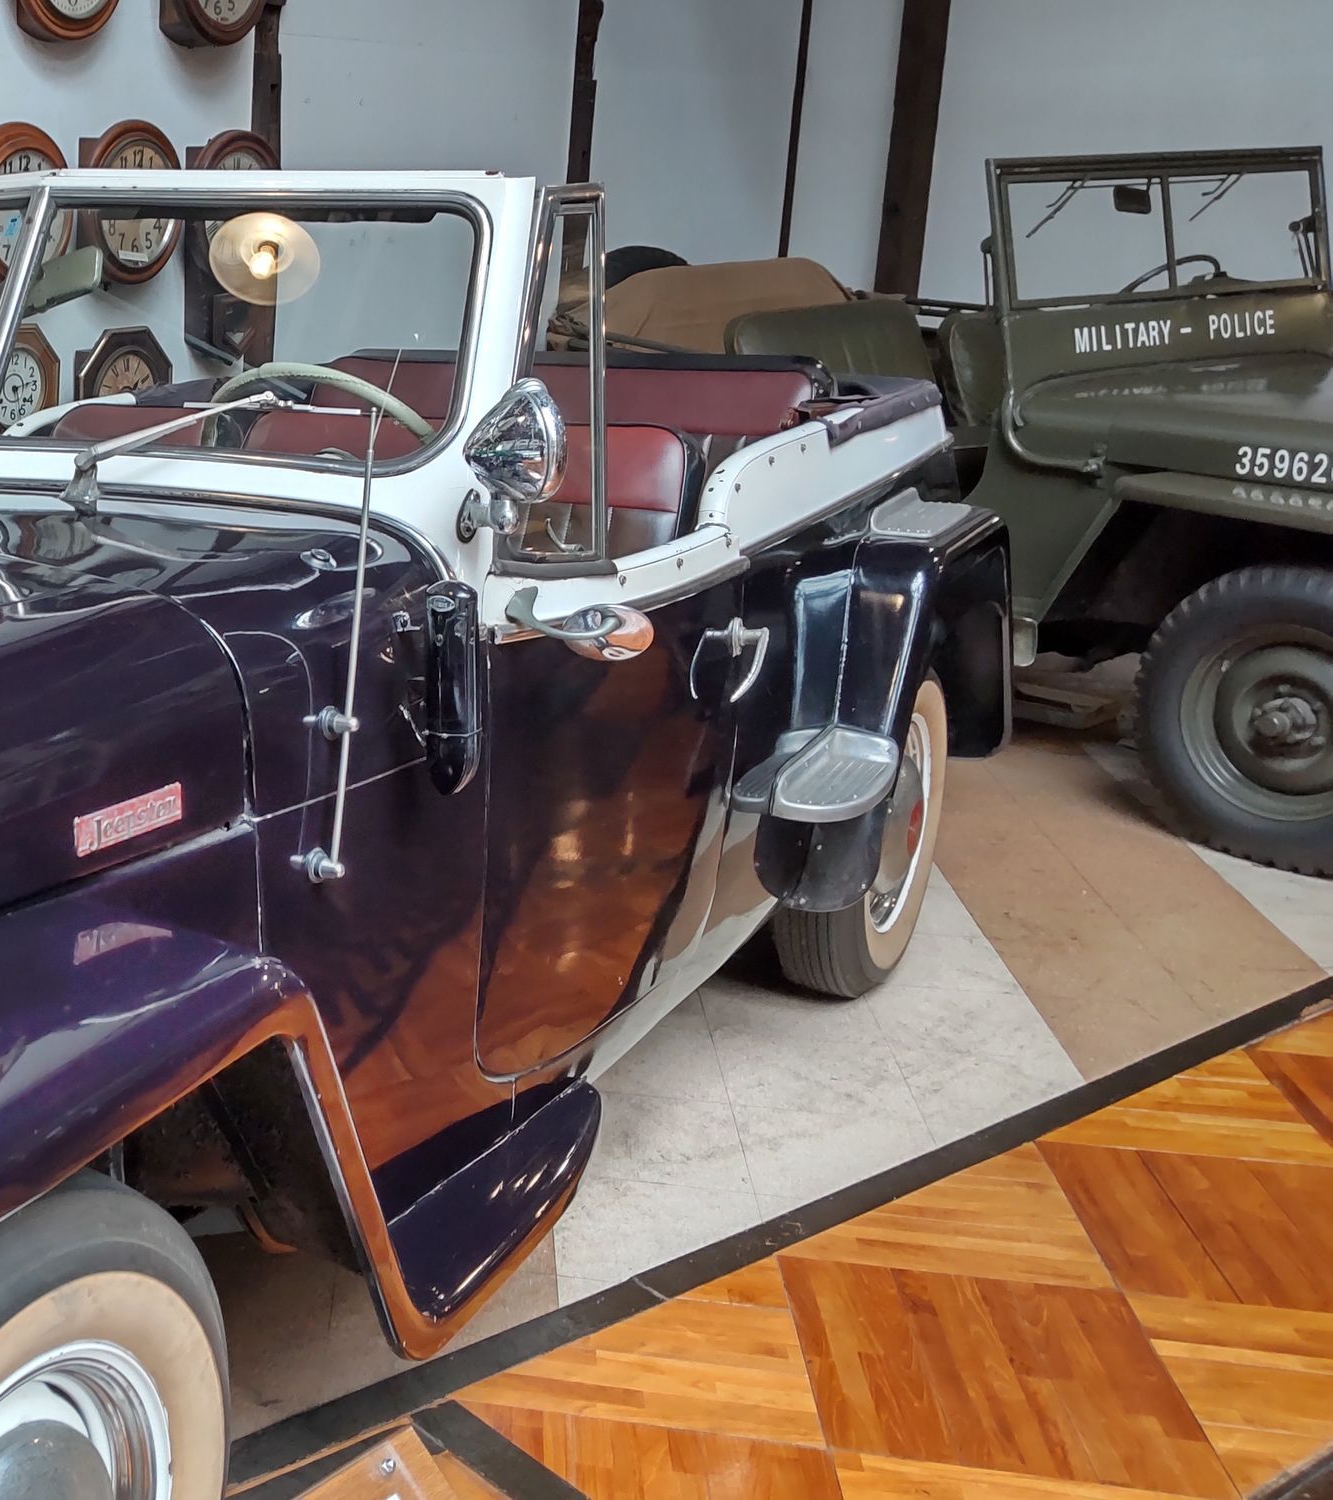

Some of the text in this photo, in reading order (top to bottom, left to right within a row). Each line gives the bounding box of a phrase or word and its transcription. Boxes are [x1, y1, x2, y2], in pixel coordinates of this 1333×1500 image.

[214, 1, 221, 15] 6
[19, 154, 30, 171] 12
[109, 220, 115, 236] 8
[153, 219, 162, 233] 4
[119, 233, 125, 250] 7
[131, 237, 139, 253] 6
[145, 232, 152, 249] 5
[2, 244, 11, 260] 7
[1074, 320, 1171, 353] MILITARY
[1208, 310, 1276, 340] POLICE
[29, 367, 34, 377] 2
[31, 381, 37, 391] 3
[1, 406, 7, 417] 7
[10, 409, 15, 420] 6
[1235, 446, 1333, 484] 35962
[88, 796, 177, 851] Jeepster
